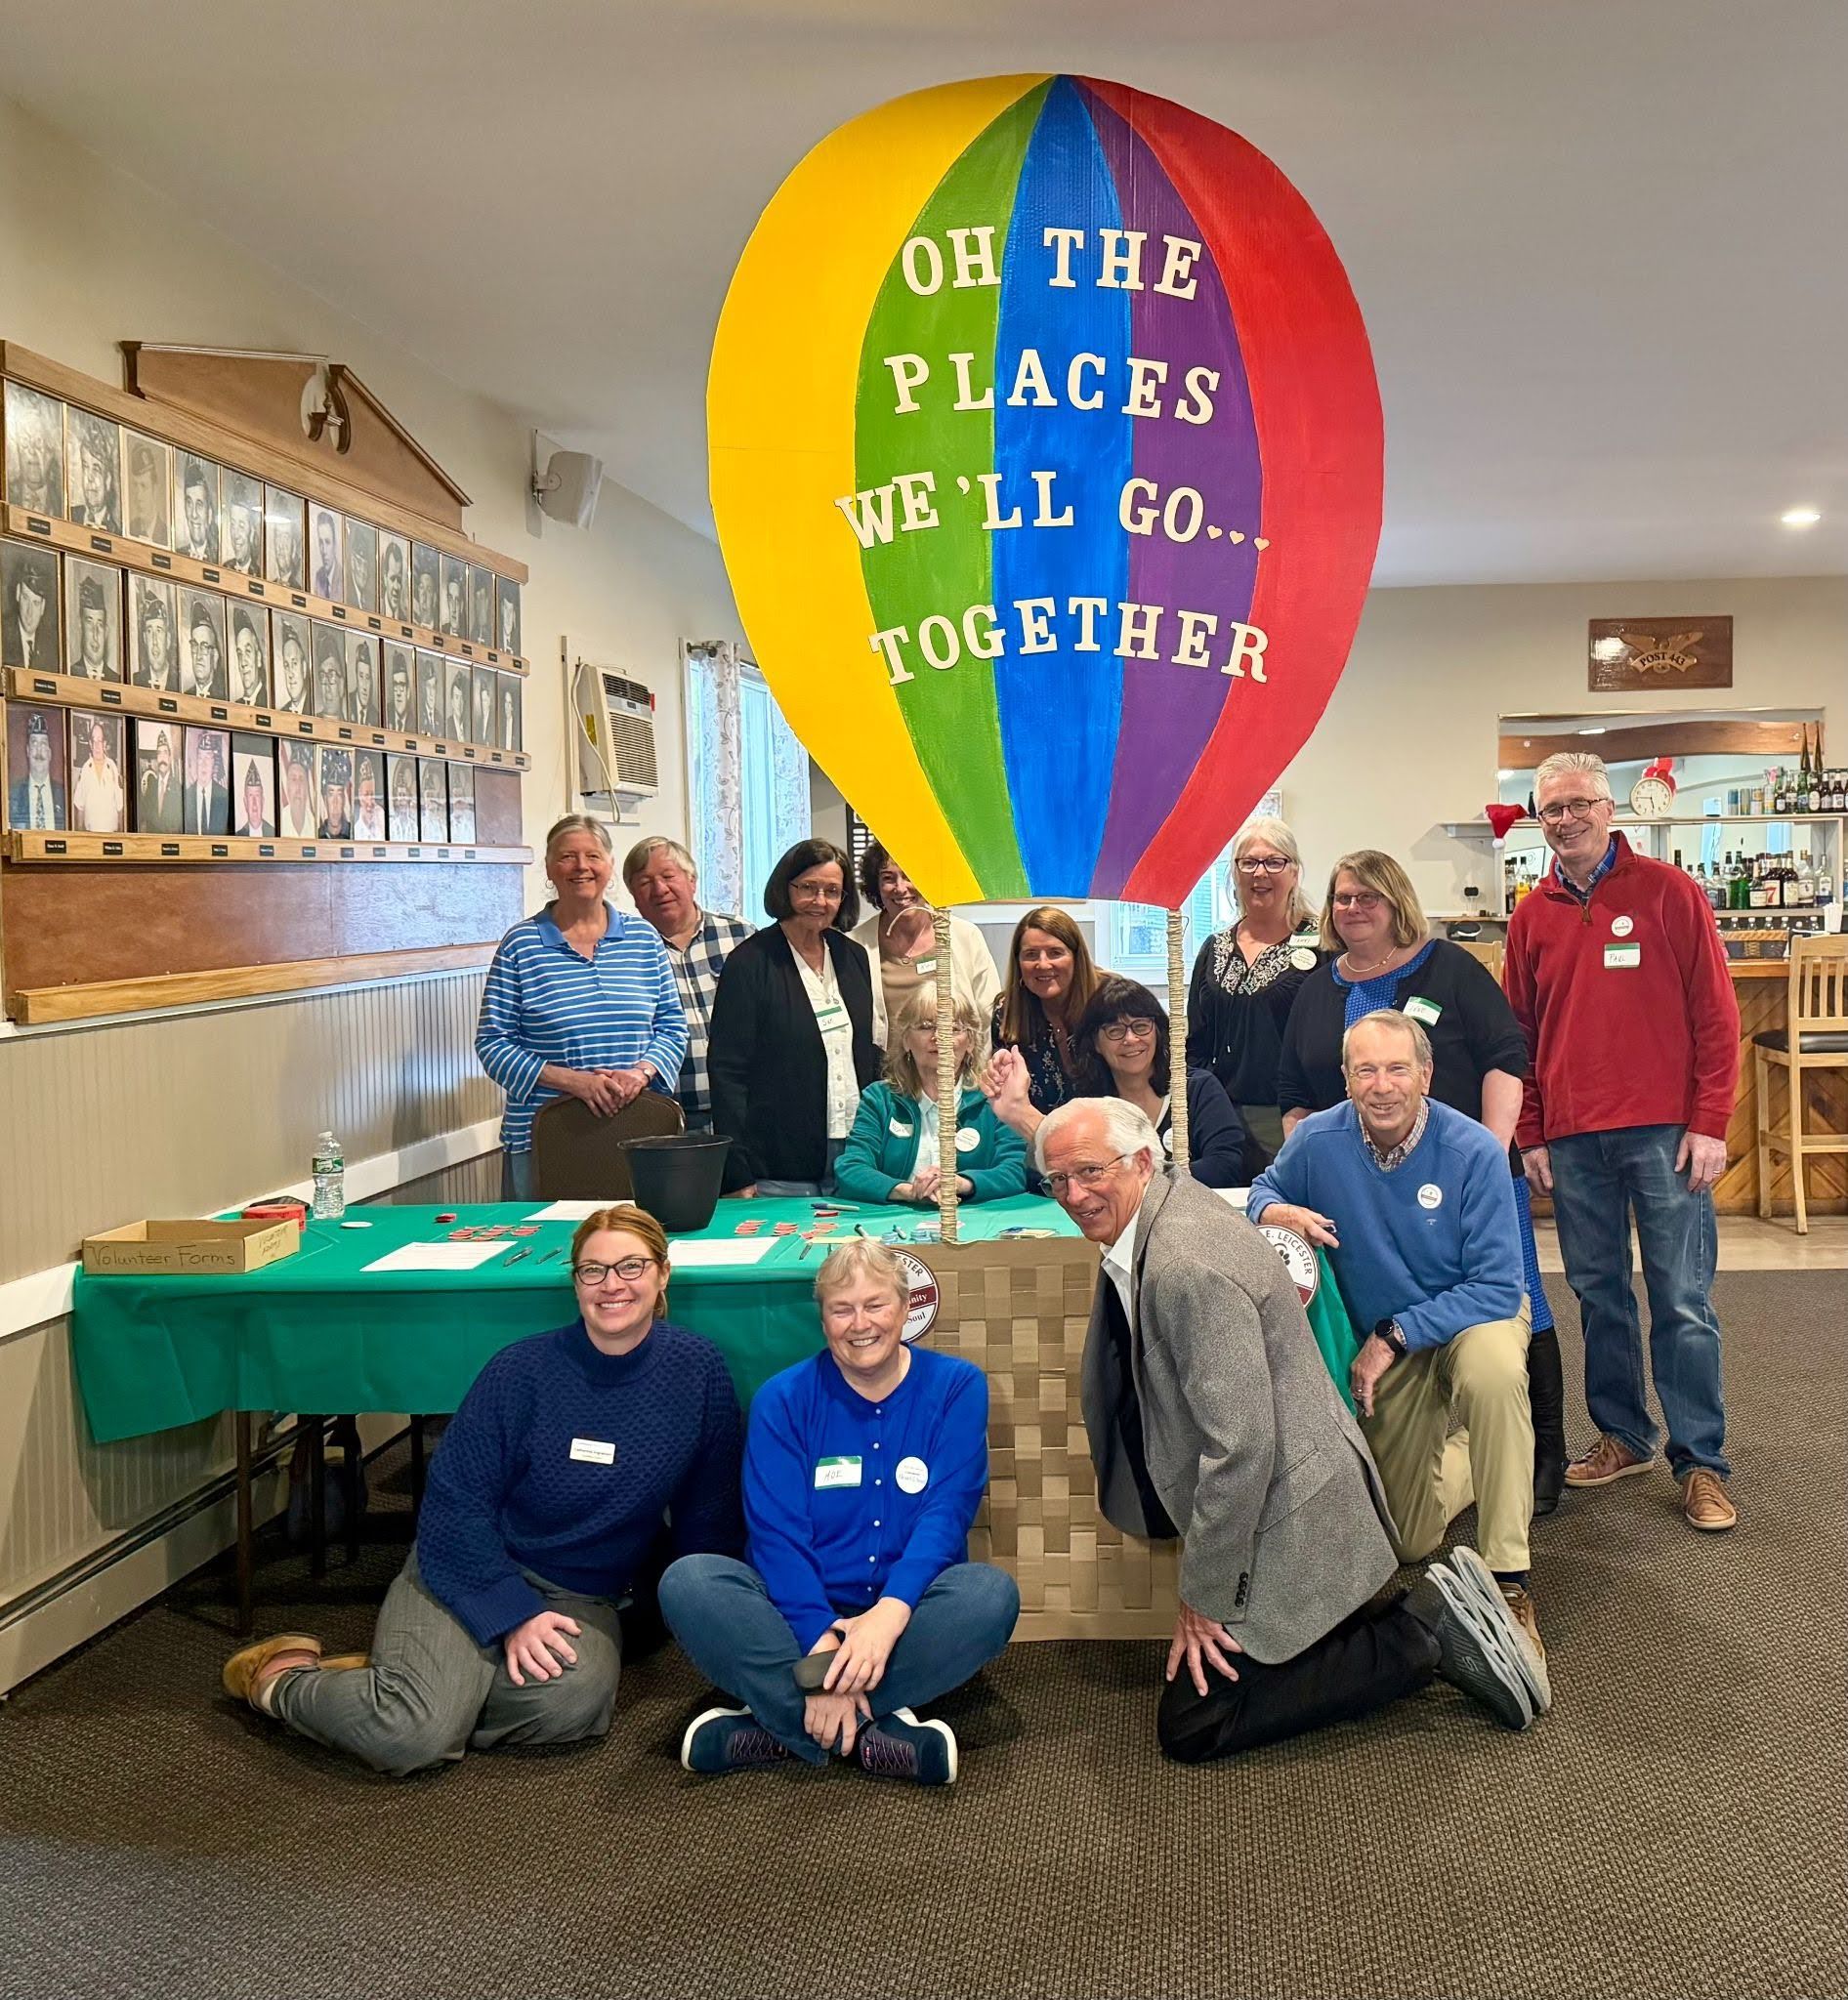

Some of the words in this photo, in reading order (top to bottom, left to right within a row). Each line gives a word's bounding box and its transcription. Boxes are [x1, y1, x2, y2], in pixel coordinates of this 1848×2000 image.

[901, 225, 1003, 297] OH
[1042, 227, 1203, 301] THE
[883, 348, 1222, 426] PLACES
[834, 471, 1073, 549] WE'LL
[868, 596, 1269, 686] TOGETHER
[1639, 651, 1668, 667] POST
[1669, 652, 1686, 666] 443
[85, 1245, 172, 1267] Volunteer
[176, 1244, 235, 1267] Forms
[1266, 1229, 1275, 1238] E.
[1278, 1231, 1313, 1274] LEICESTER
